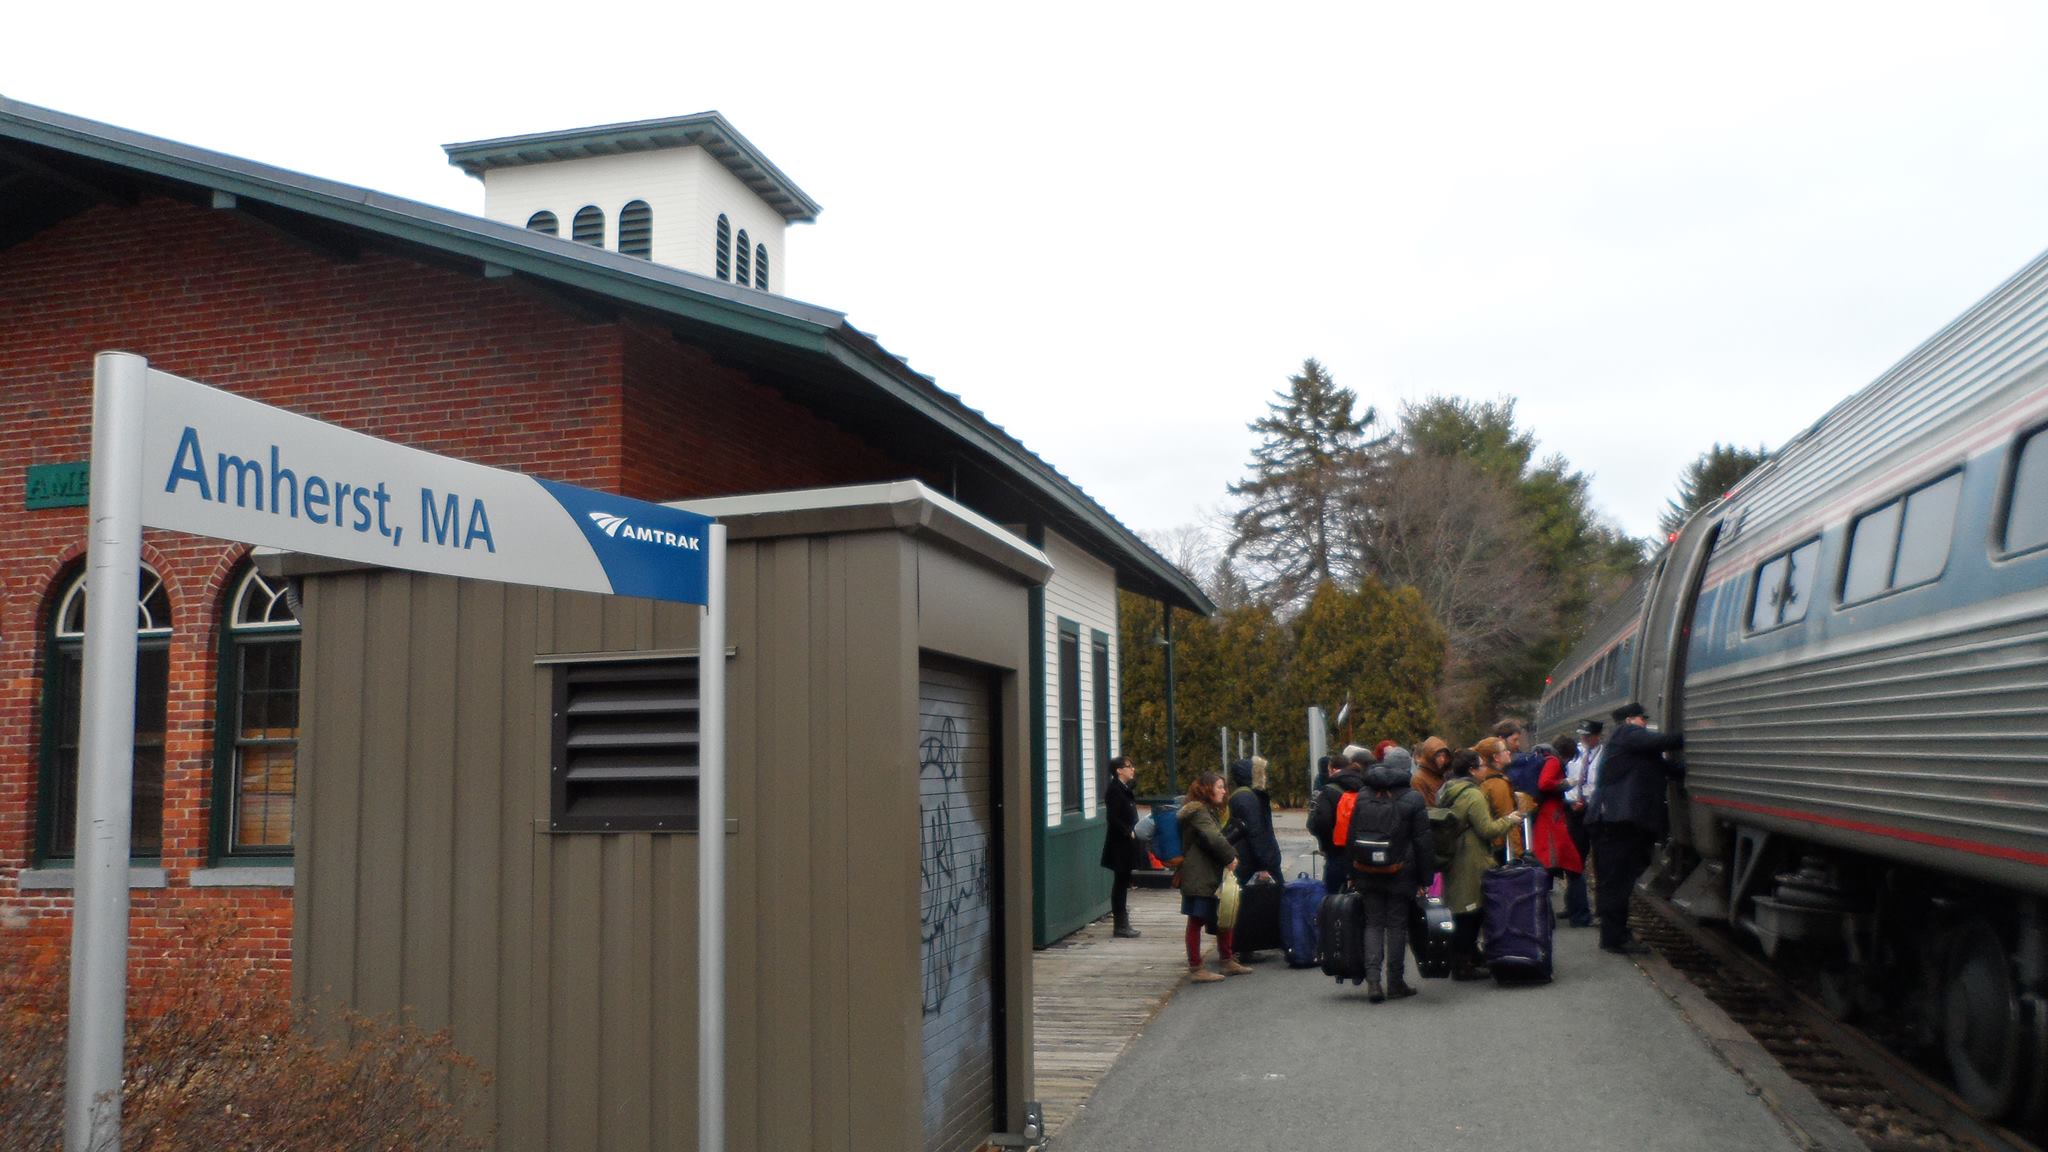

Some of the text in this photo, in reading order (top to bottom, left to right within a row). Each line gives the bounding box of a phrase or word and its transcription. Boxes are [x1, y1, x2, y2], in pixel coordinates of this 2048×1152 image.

[164, 426, 496, 553] Amherst, MA
[622, 524, 700, 551] AMTRAK
